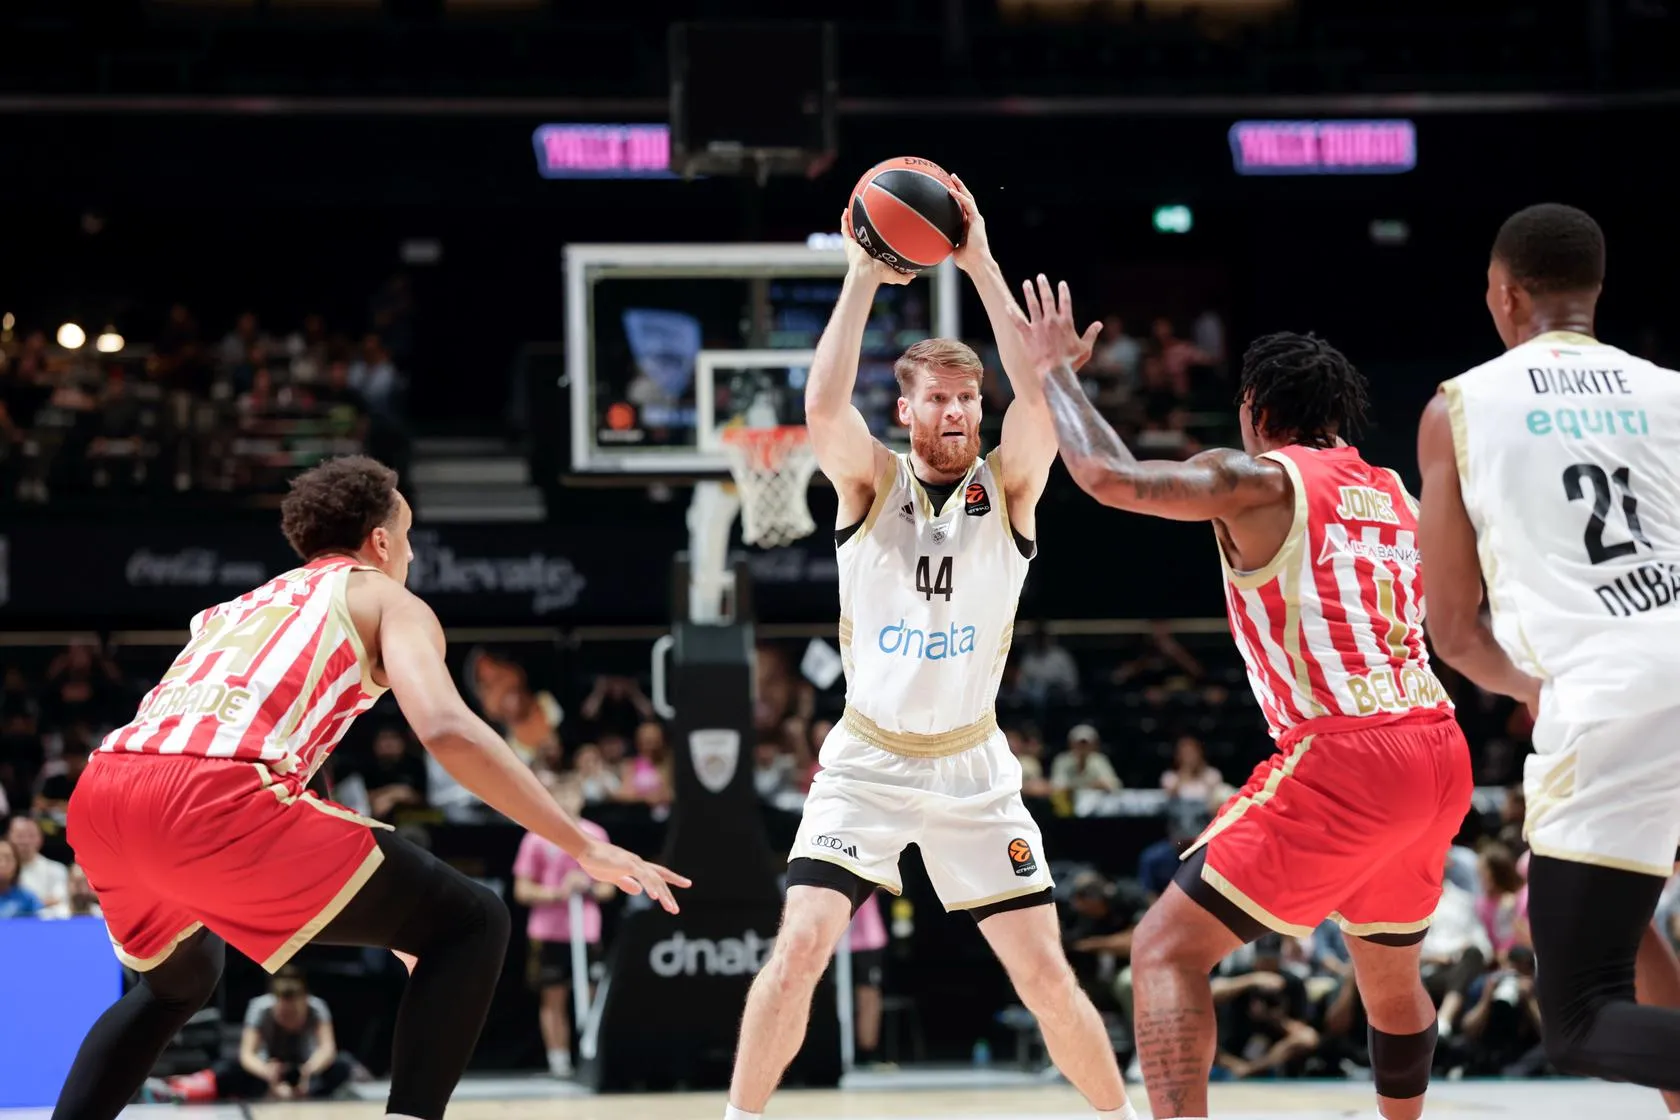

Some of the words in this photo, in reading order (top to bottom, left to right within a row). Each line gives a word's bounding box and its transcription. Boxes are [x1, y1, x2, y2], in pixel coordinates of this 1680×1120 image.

[1528, 367, 1632, 395] DIAKITE
[1337, 487, 1398, 523] JONES
[1562, 463, 1653, 565] 21
[915, 555, 953, 601] 44
[879, 619, 976, 660] dnata
